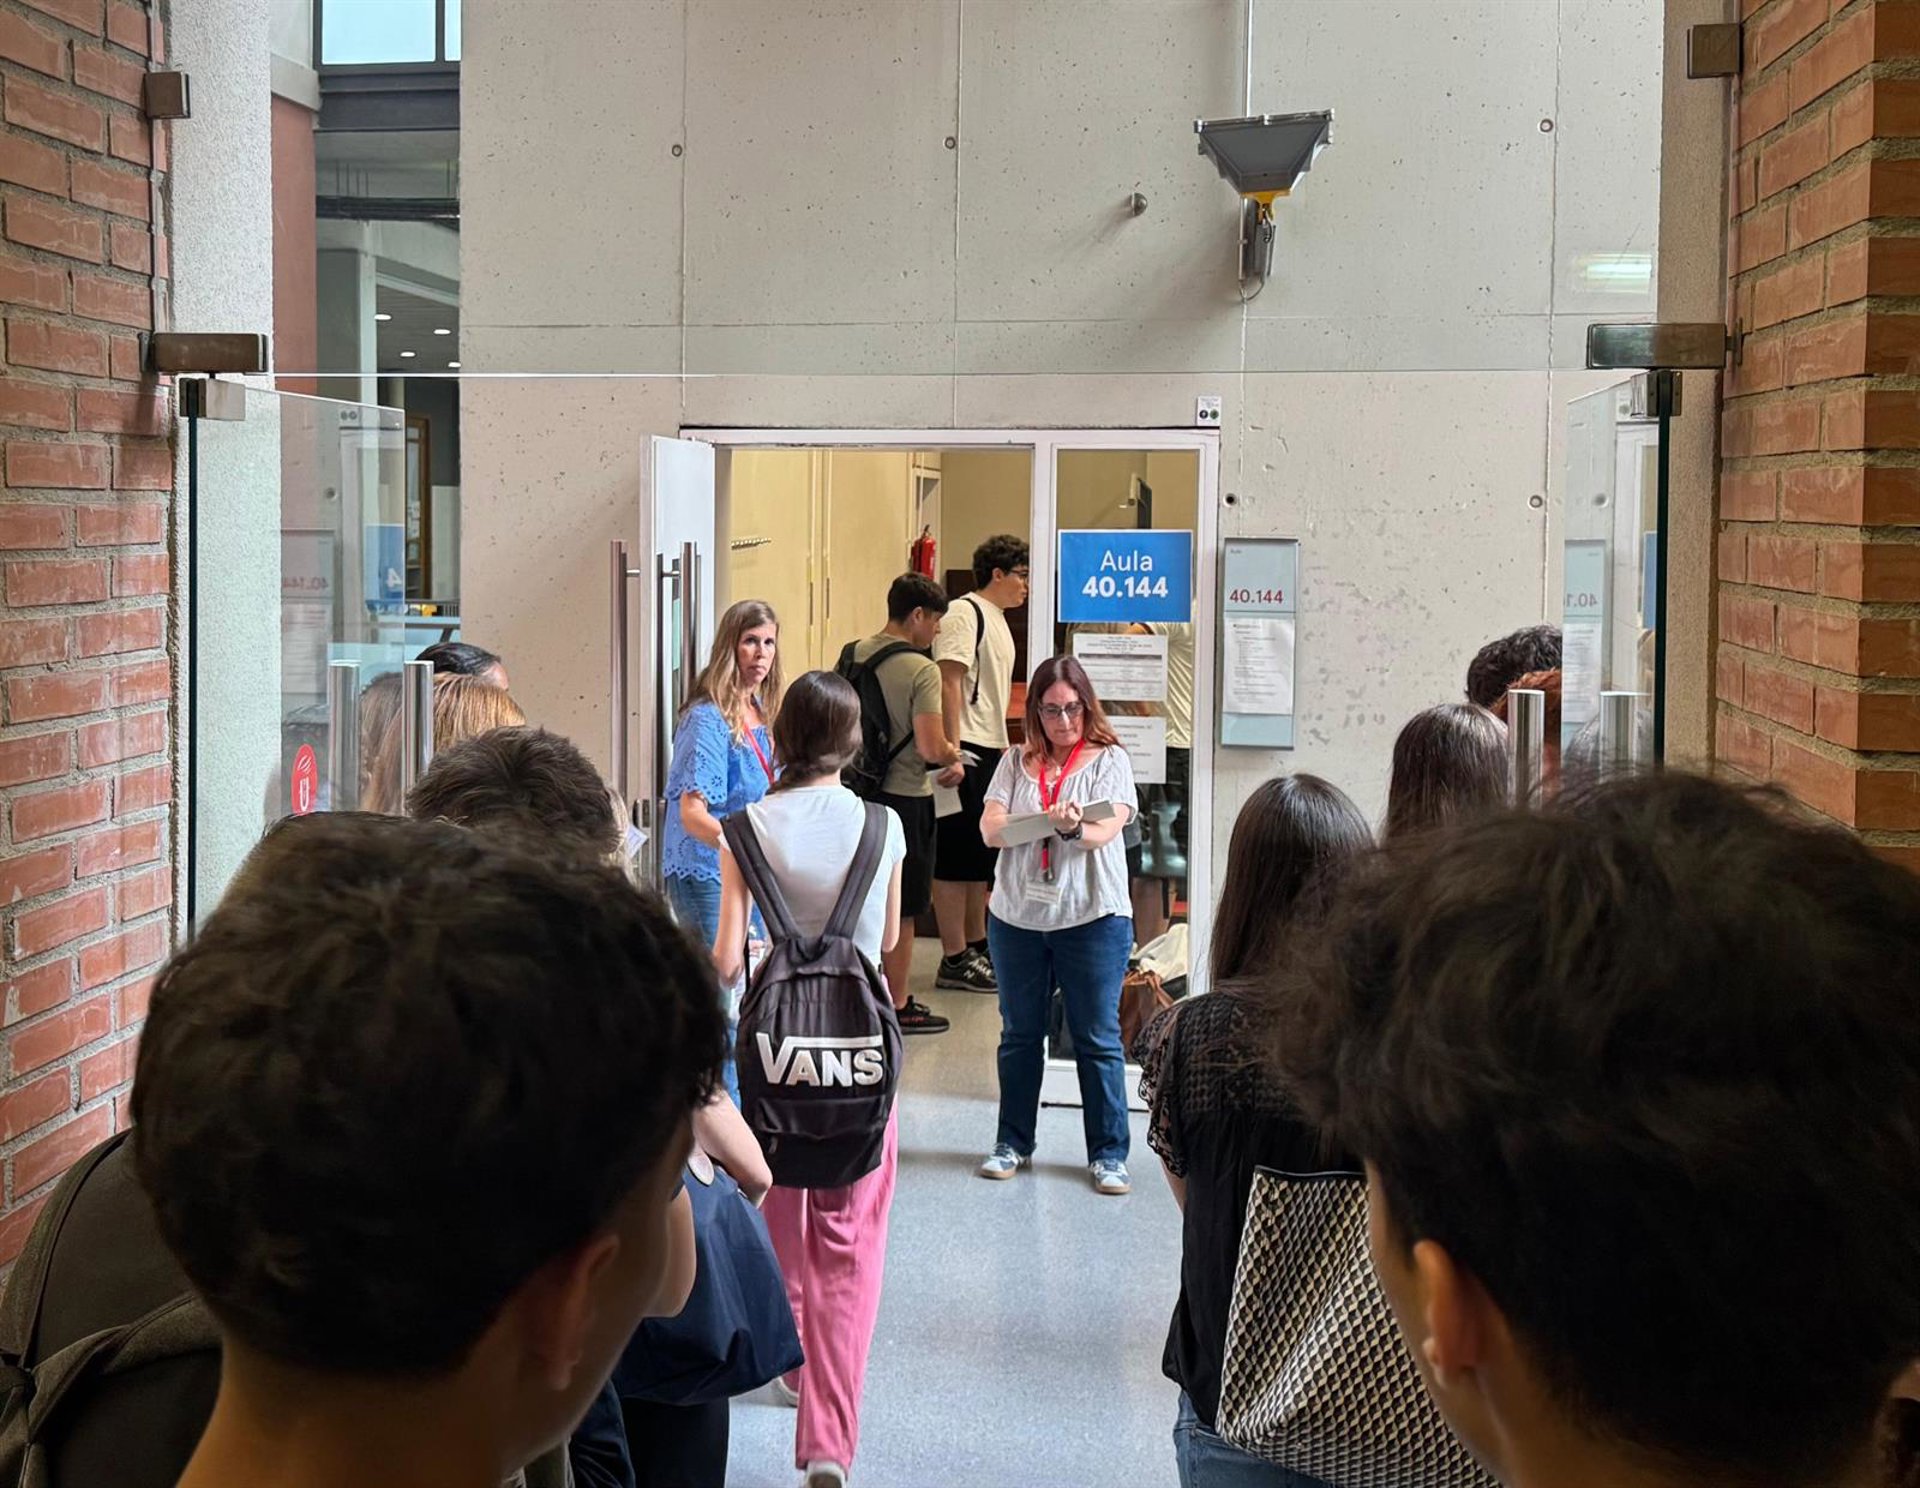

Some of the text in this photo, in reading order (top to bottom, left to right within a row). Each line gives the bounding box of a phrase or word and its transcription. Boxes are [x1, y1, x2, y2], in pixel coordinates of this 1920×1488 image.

[1100, 549, 1153, 572] Aula
[1082, 575, 1168, 598] 40.144
[1229, 588, 1284, 604] 40.144
[756, 1032, 884, 1087] VANS
